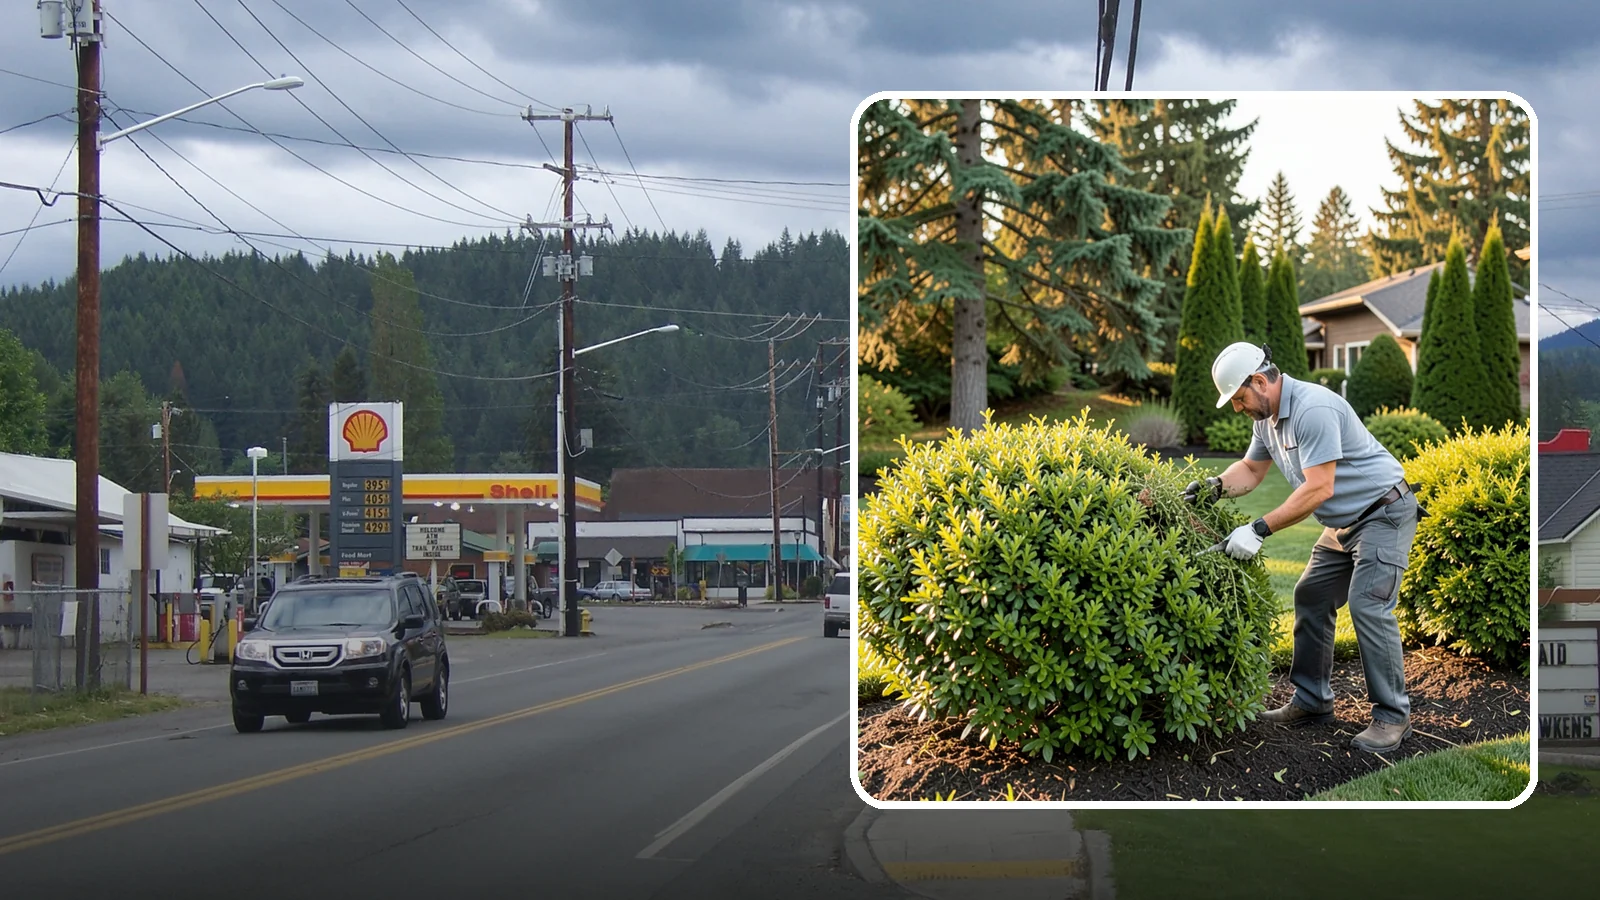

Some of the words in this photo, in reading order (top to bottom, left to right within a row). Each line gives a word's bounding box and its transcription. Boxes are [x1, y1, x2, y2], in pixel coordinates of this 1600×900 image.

[365, 480, 384, 490] 395
[490, 484, 547, 499] Shell
[365, 494, 384, 504] 405
[365, 508, 384, 518] 415
[365, 522, 384, 532] 429
